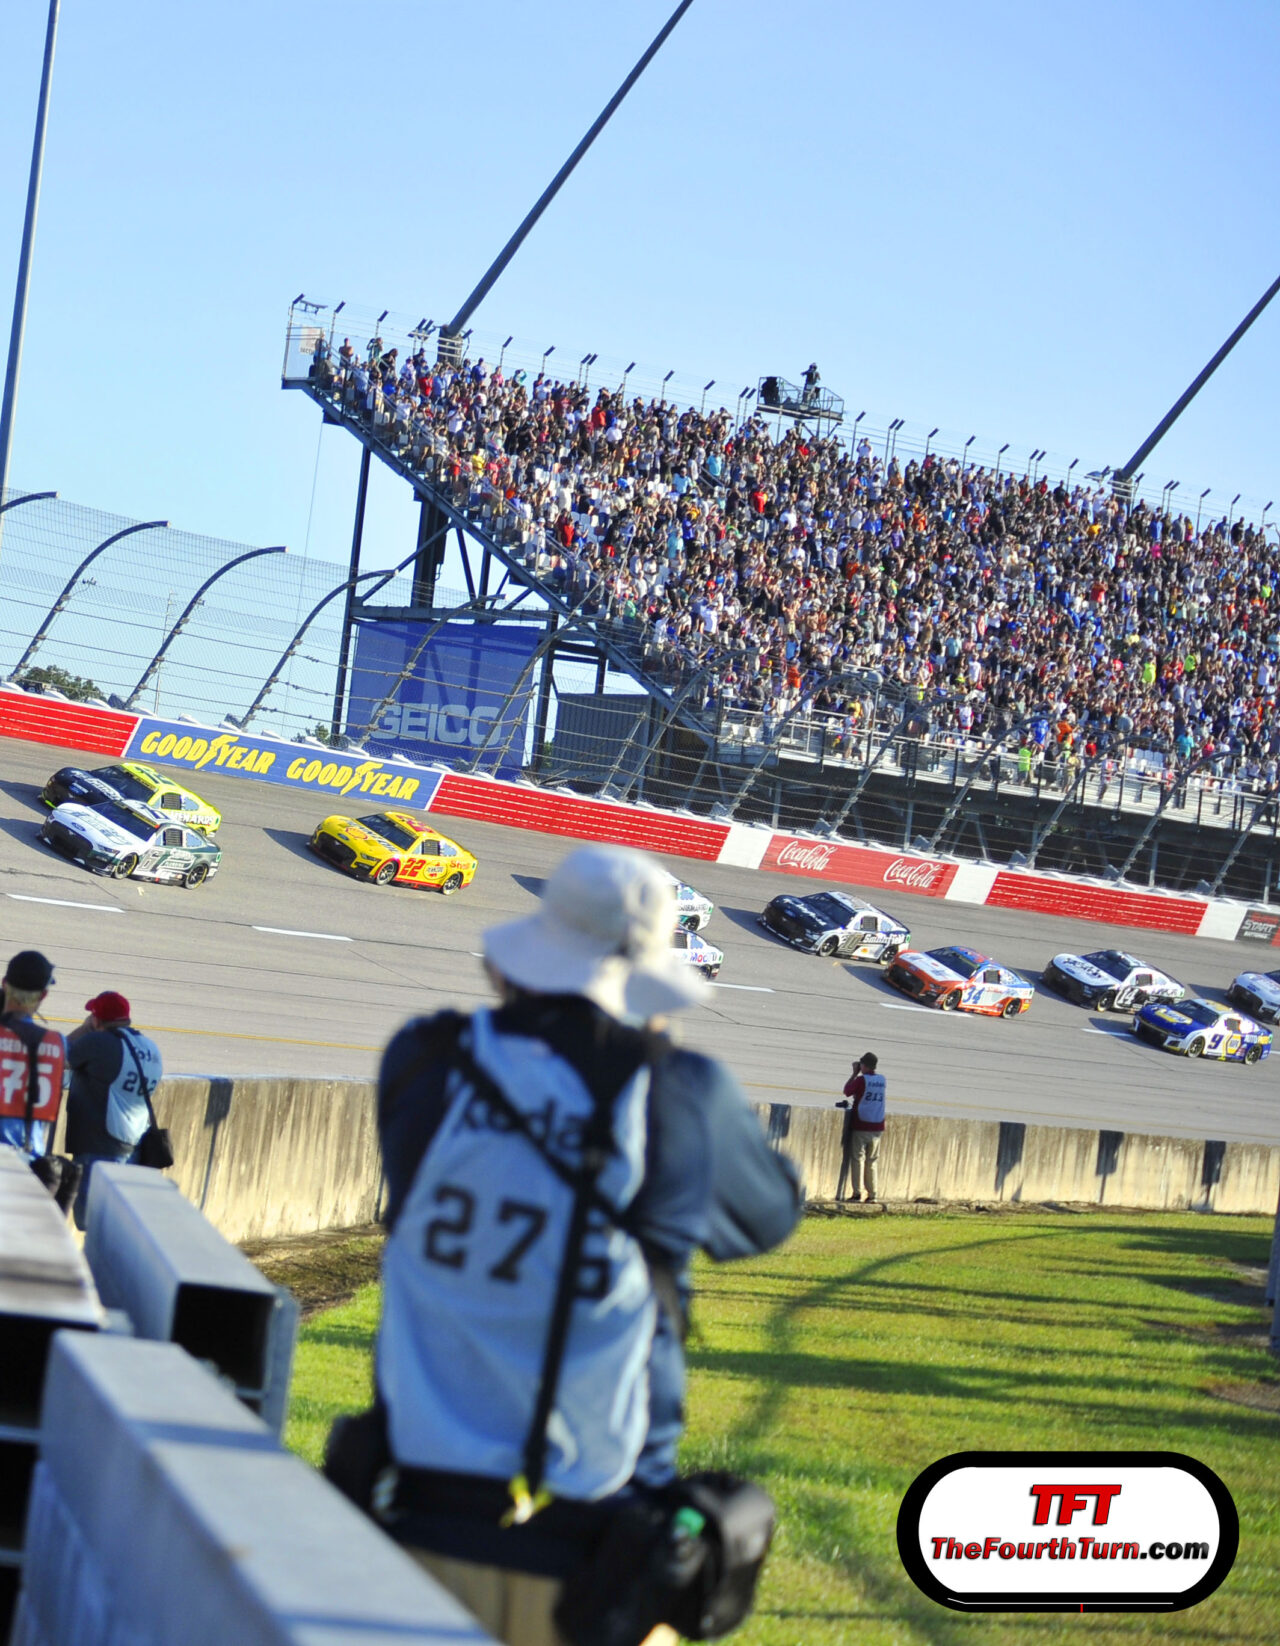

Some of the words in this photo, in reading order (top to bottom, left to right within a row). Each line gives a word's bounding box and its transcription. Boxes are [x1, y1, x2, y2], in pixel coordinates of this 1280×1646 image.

[369, 702, 503, 745] GEICO
[140, 731, 276, 775] GOODYEAR
[286, 757, 421, 801] GOODYEAR
[400, 858, 427, 877] 22
[962, 986, 986, 1004] 34
[1118, 987, 1139, 1005] 14
[1208, 1034, 1224, 1050] 9
